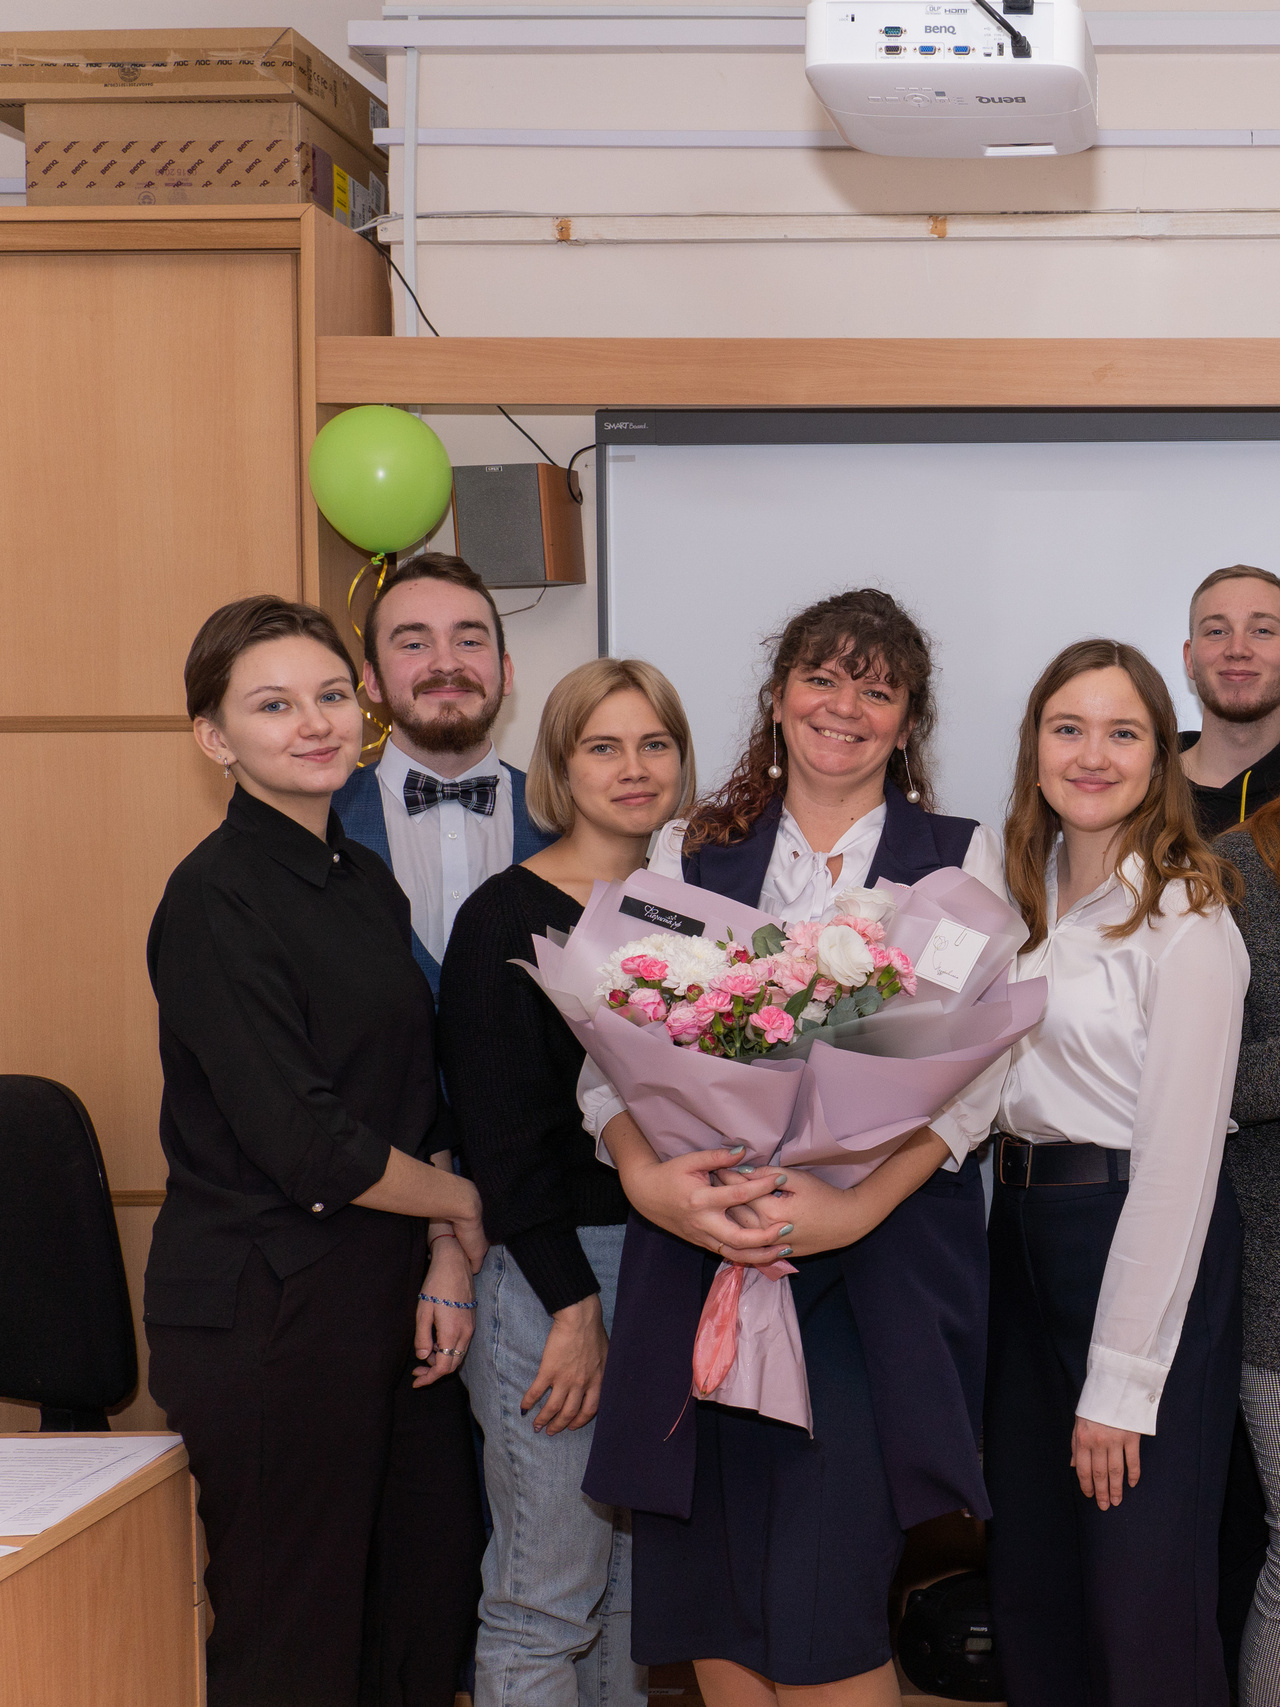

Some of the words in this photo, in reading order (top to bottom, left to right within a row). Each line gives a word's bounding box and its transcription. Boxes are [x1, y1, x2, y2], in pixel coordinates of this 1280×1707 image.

[924, 25, 957, 35] BenQ
[976, 95, 1027, 104] BenQ
[42, 159, 59, 175] BenQ
[71, 159, 88, 175] BenQ
[100, 159, 117, 175] BenQ
[129, 159, 146, 175] BenQ
[158, 159, 175, 175] BenQ
[187, 159, 204, 175] BenQ
[216, 158, 233, 174] BenQ
[245, 158, 262, 174] BenQ
[273, 158, 290, 174] BenQ
[603, 421, 629, 430] SMART
